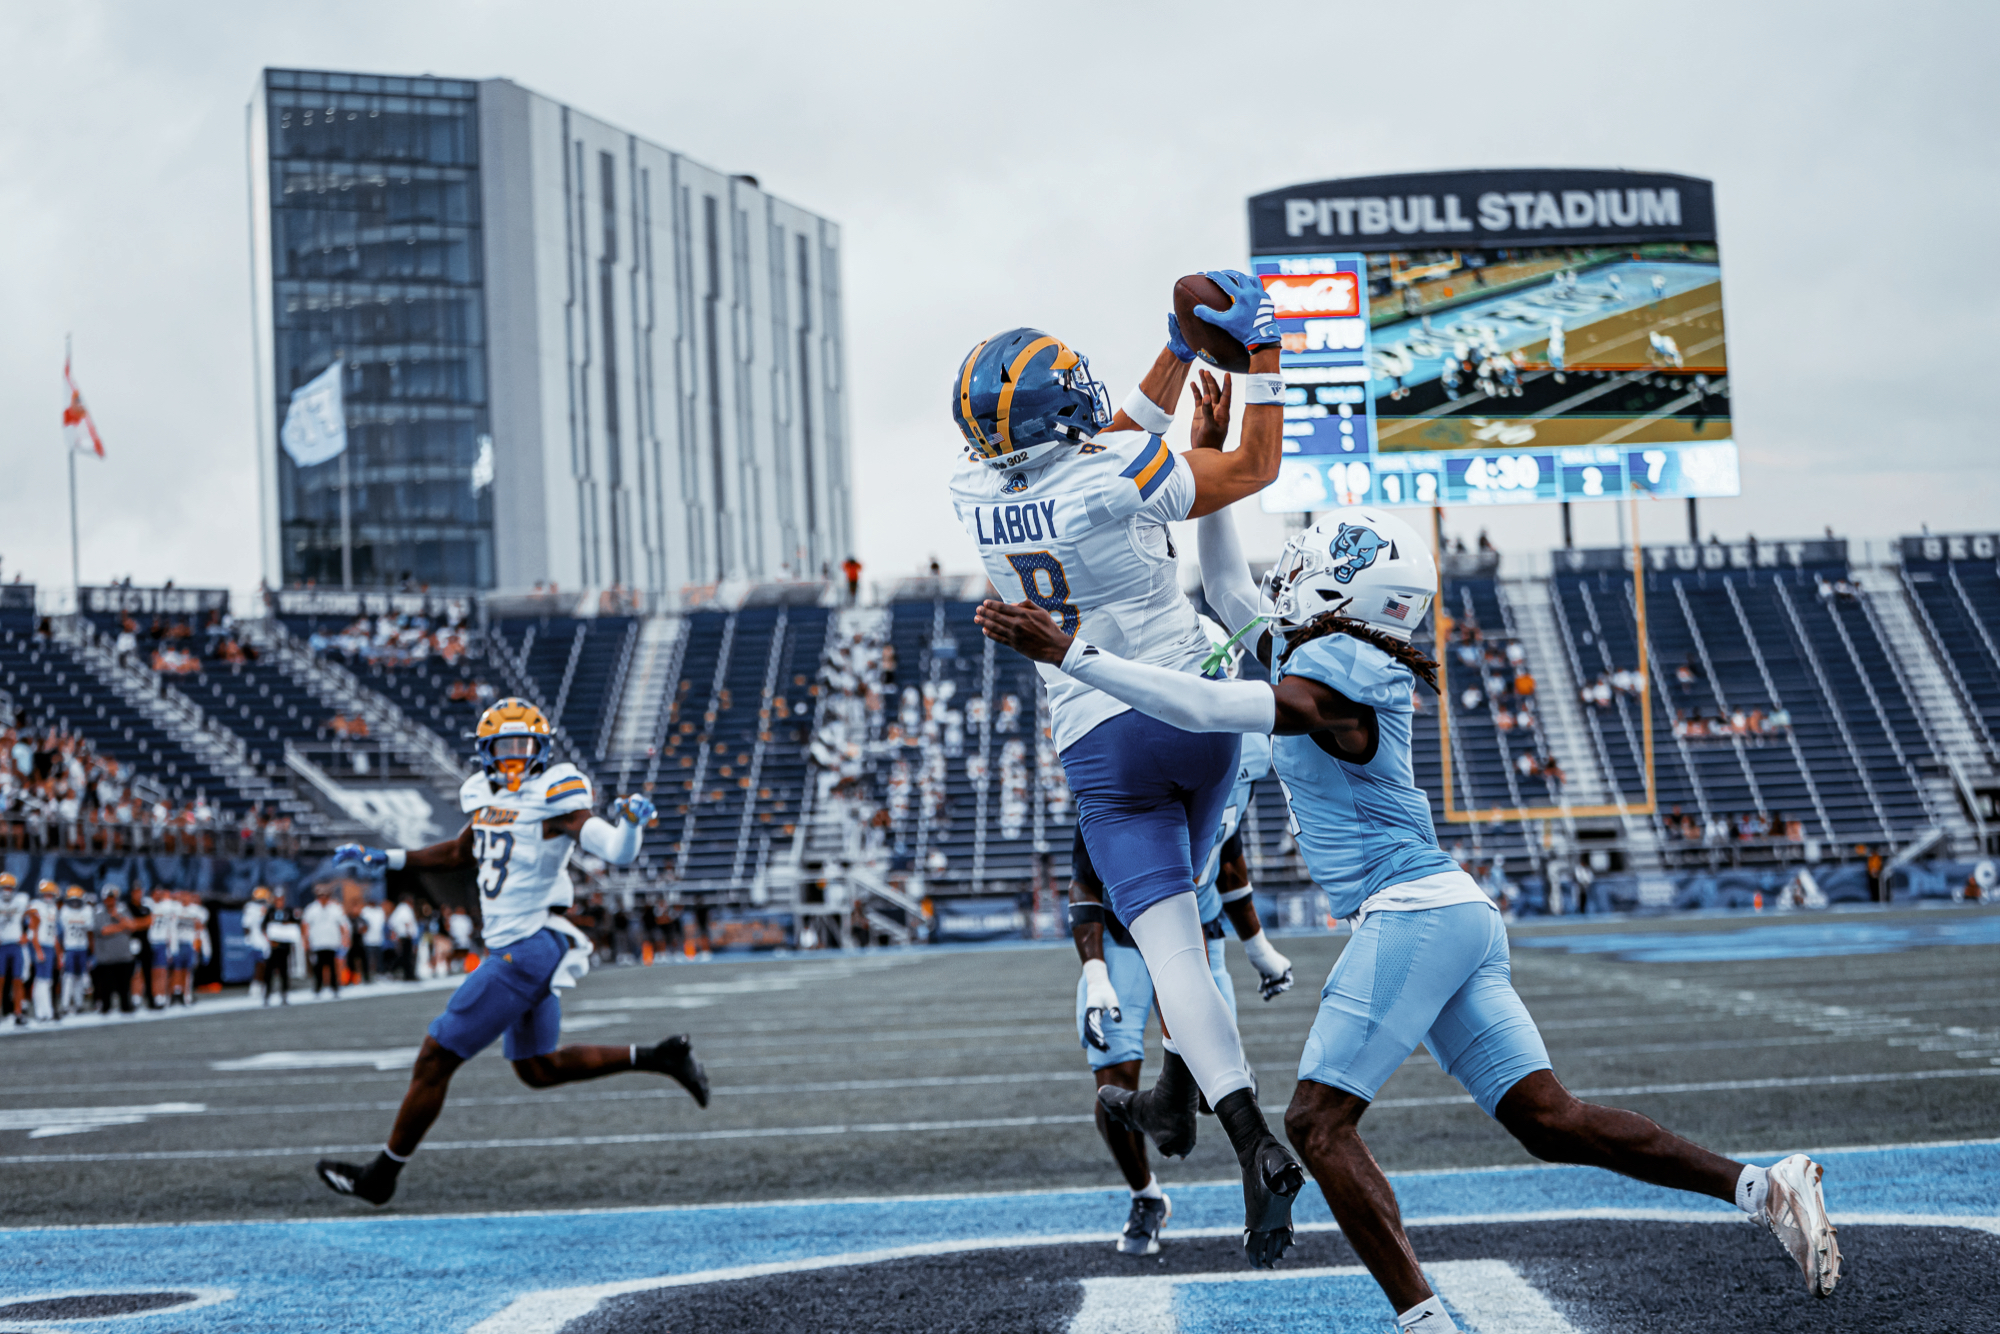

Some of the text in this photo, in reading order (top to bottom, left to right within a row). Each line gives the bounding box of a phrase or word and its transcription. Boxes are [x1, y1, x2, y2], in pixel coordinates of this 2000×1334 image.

[1285, 187, 1682, 237] PITBULL STADIUM
[1006, 451, 1030, 467] 302
[1464, 454, 1540, 490] 4:30
[1642, 450, 1667, 484] 7
[1327, 462, 1371, 496] 10
[1382, 474, 1401, 503] 1
[974, 498, 1058, 545] LABOY
[1005, 549, 1081, 638] 8
